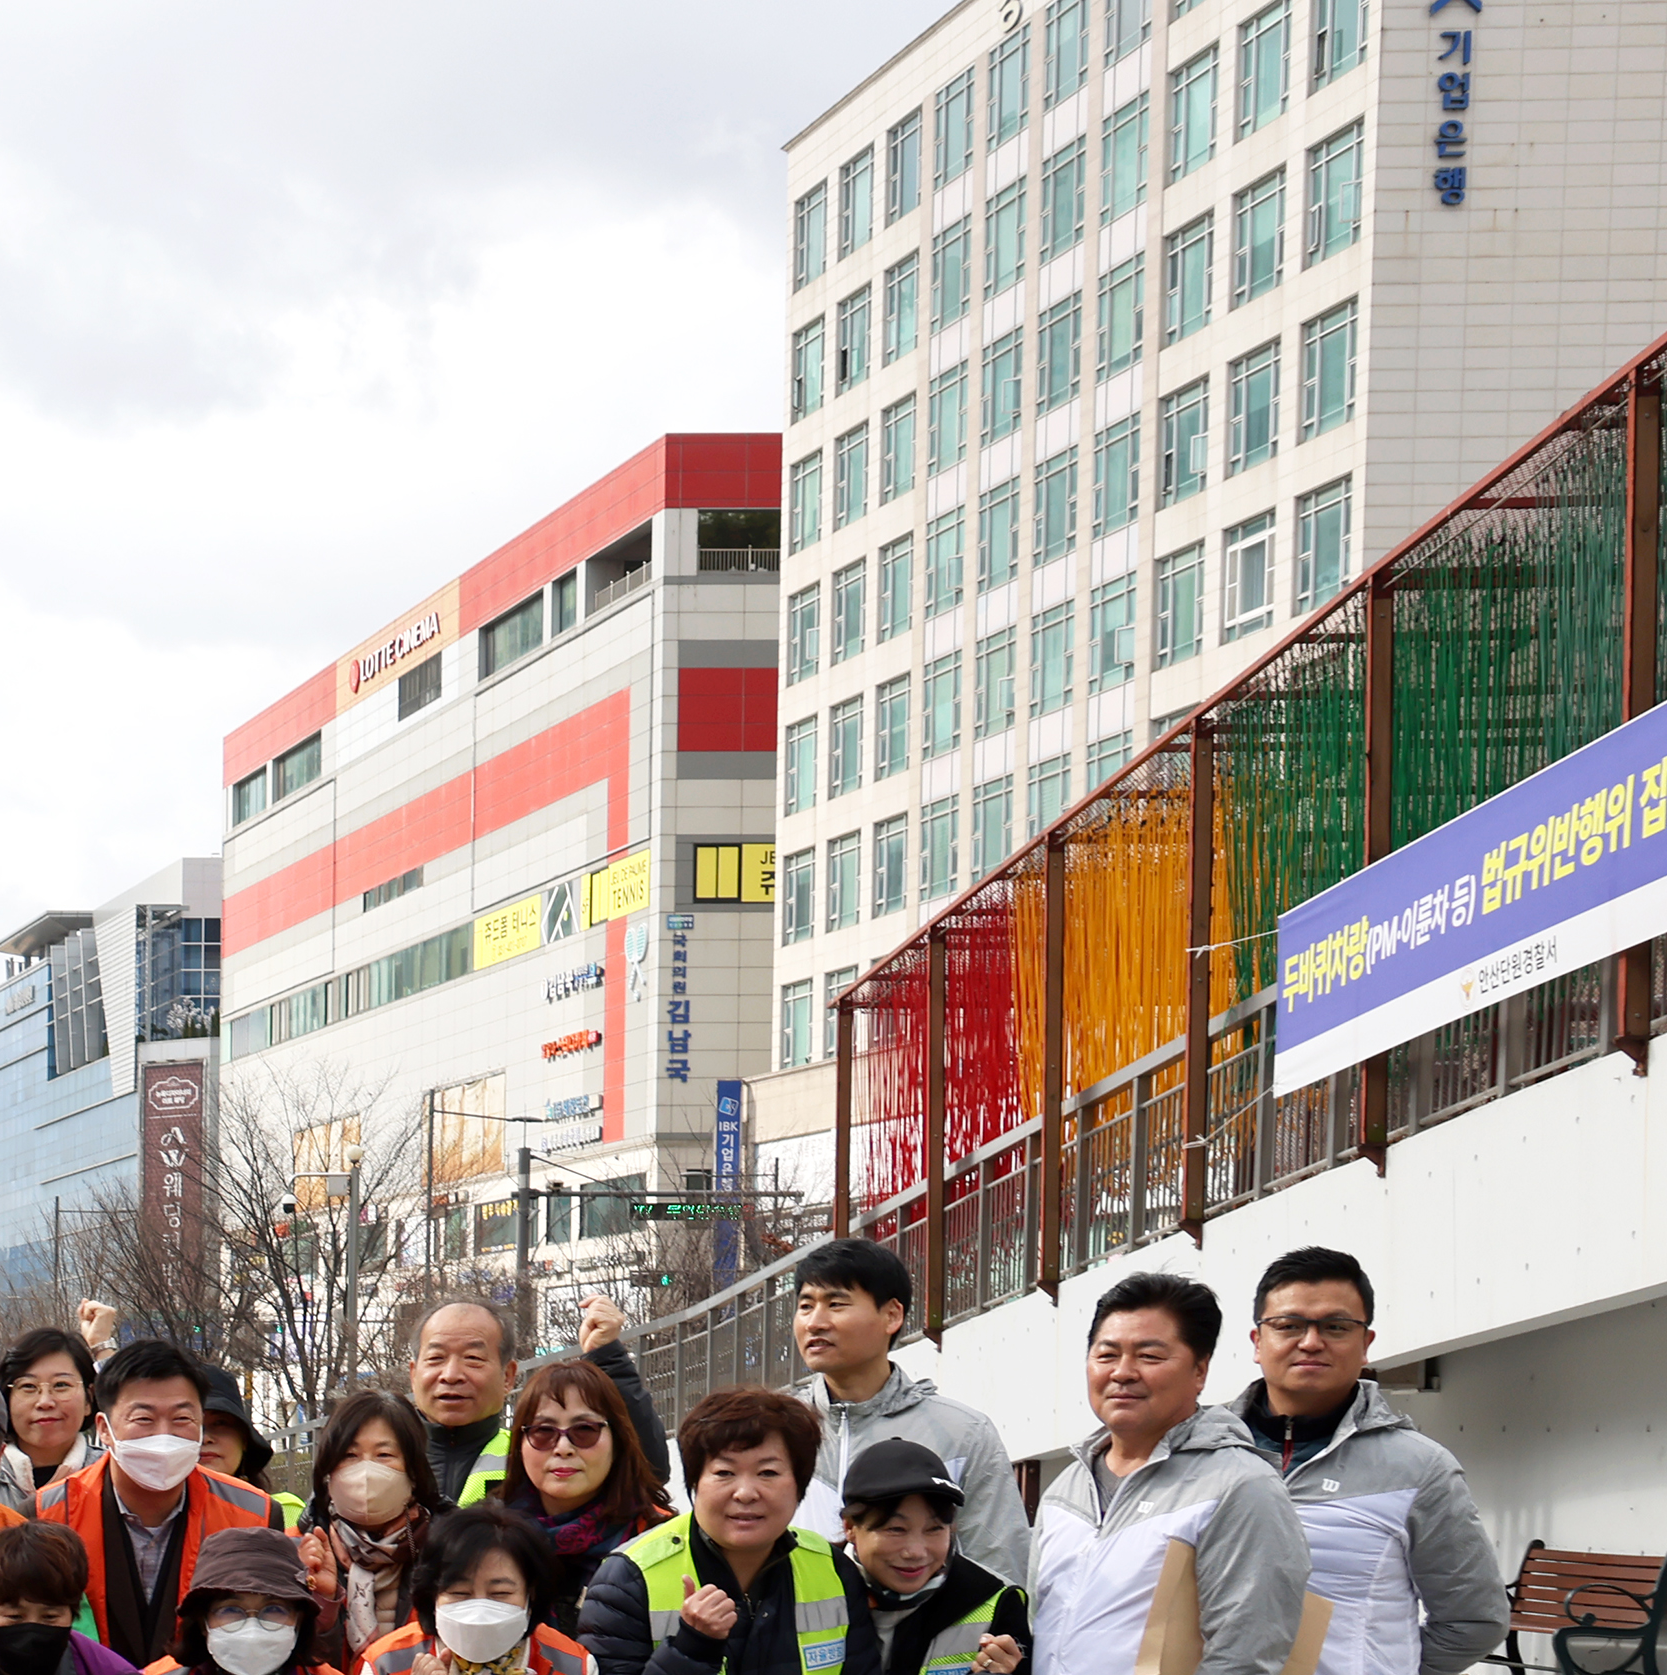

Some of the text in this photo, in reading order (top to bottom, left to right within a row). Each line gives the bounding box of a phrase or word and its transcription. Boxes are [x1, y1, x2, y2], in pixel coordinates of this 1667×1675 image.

[1433, 30, 1472, 206] 기업은행
[360, 611, 441, 683] LOTTE CINEMA
[1481, 773, 1636, 916] 법규위반행위
[511, 906, 538, 933] 테니스
[612, 881, 646, 909] TENNIS
[672, 931, 688, 995] 국회의원
[1478, 935, 1559, 996] 안산단원경찰서
[667, 1000, 692, 1084] 김남국
[718, 1120, 739, 1132] IBK
